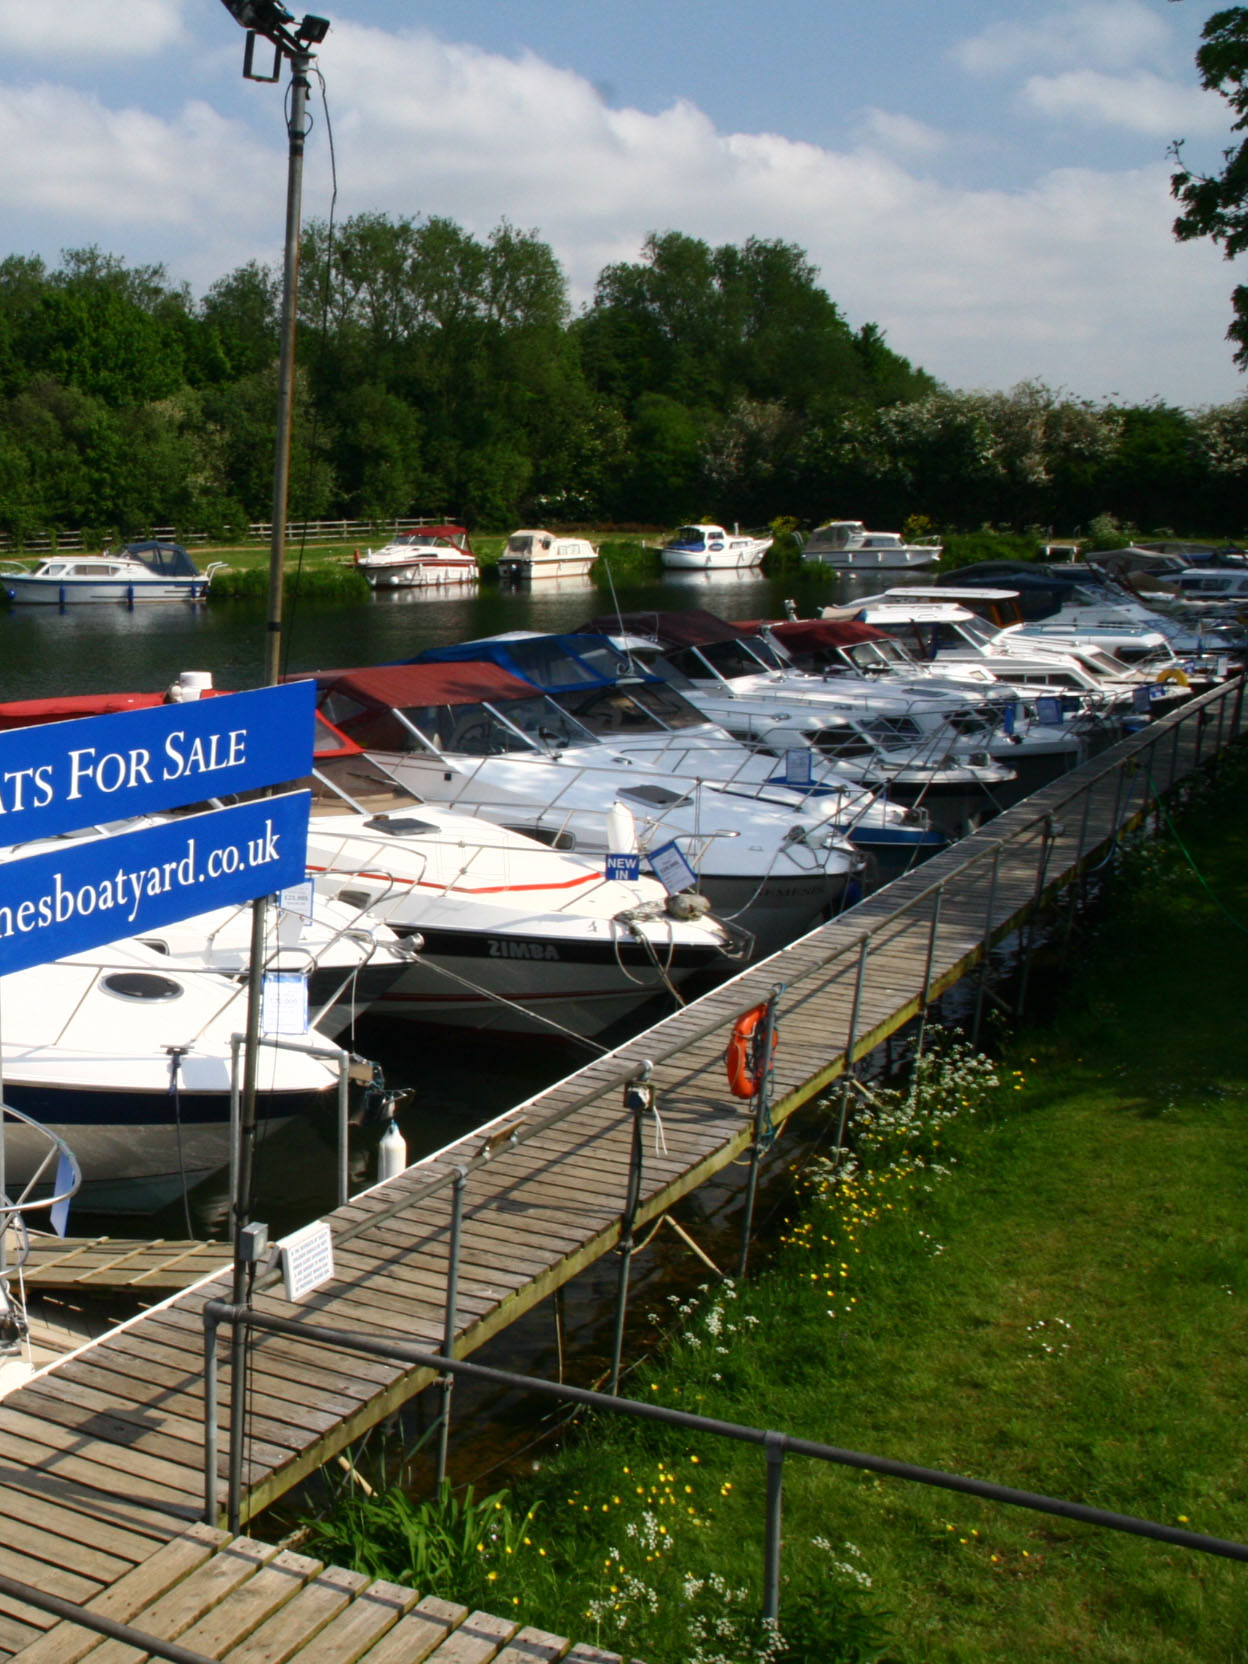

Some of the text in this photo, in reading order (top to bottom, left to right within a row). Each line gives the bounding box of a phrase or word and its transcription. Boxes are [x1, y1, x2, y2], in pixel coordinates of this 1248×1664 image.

[67, 748, 152, 800] FOR
[163, 730, 247, 780] SALE
[607, 857, 637, 869] NEW
[615, 870, 629, 880] IN
[488, 940, 560, 960] ZIMBA
